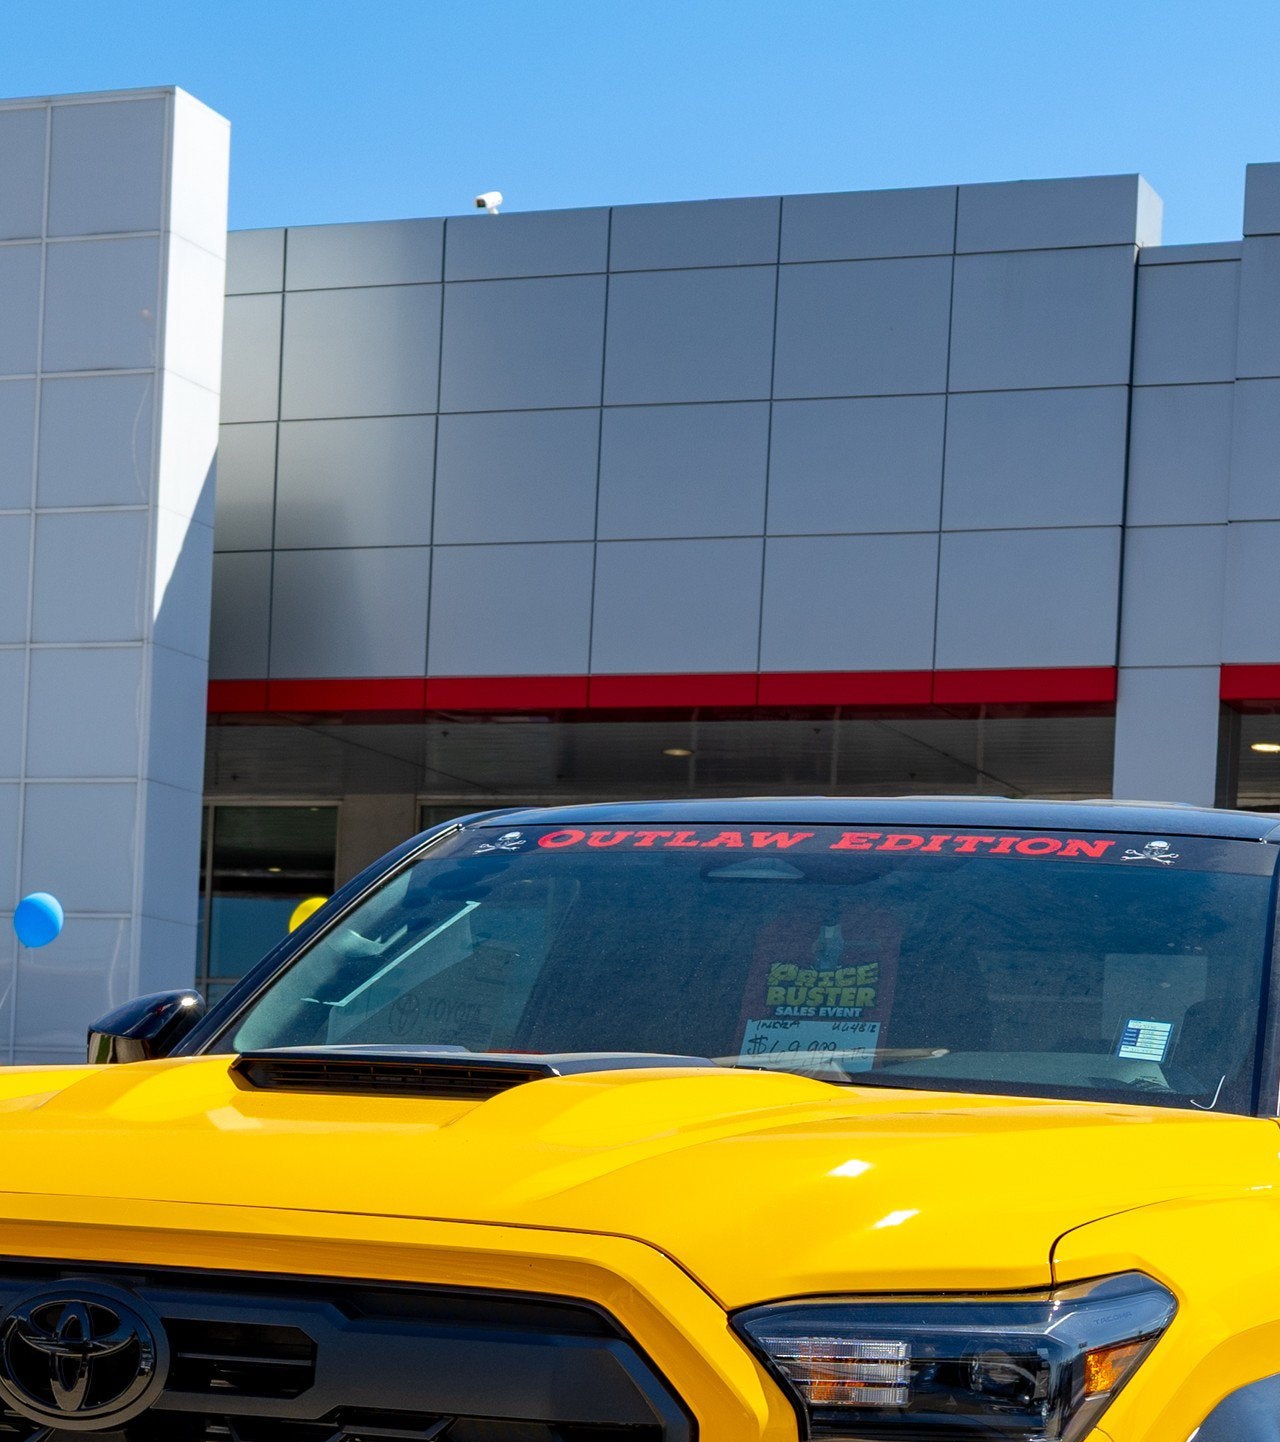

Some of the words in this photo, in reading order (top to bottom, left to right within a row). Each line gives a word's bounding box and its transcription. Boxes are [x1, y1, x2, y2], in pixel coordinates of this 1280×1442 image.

[537, 828, 816, 851] OUTLAW
[829, 831, 1116, 858] EDITION
[767, 962, 880, 989] PRICE
[766, 985, 877, 1007] BUSTER
[775, 1006, 816, 1017] SALES
[819, 1007, 863, 1018] EVENT
